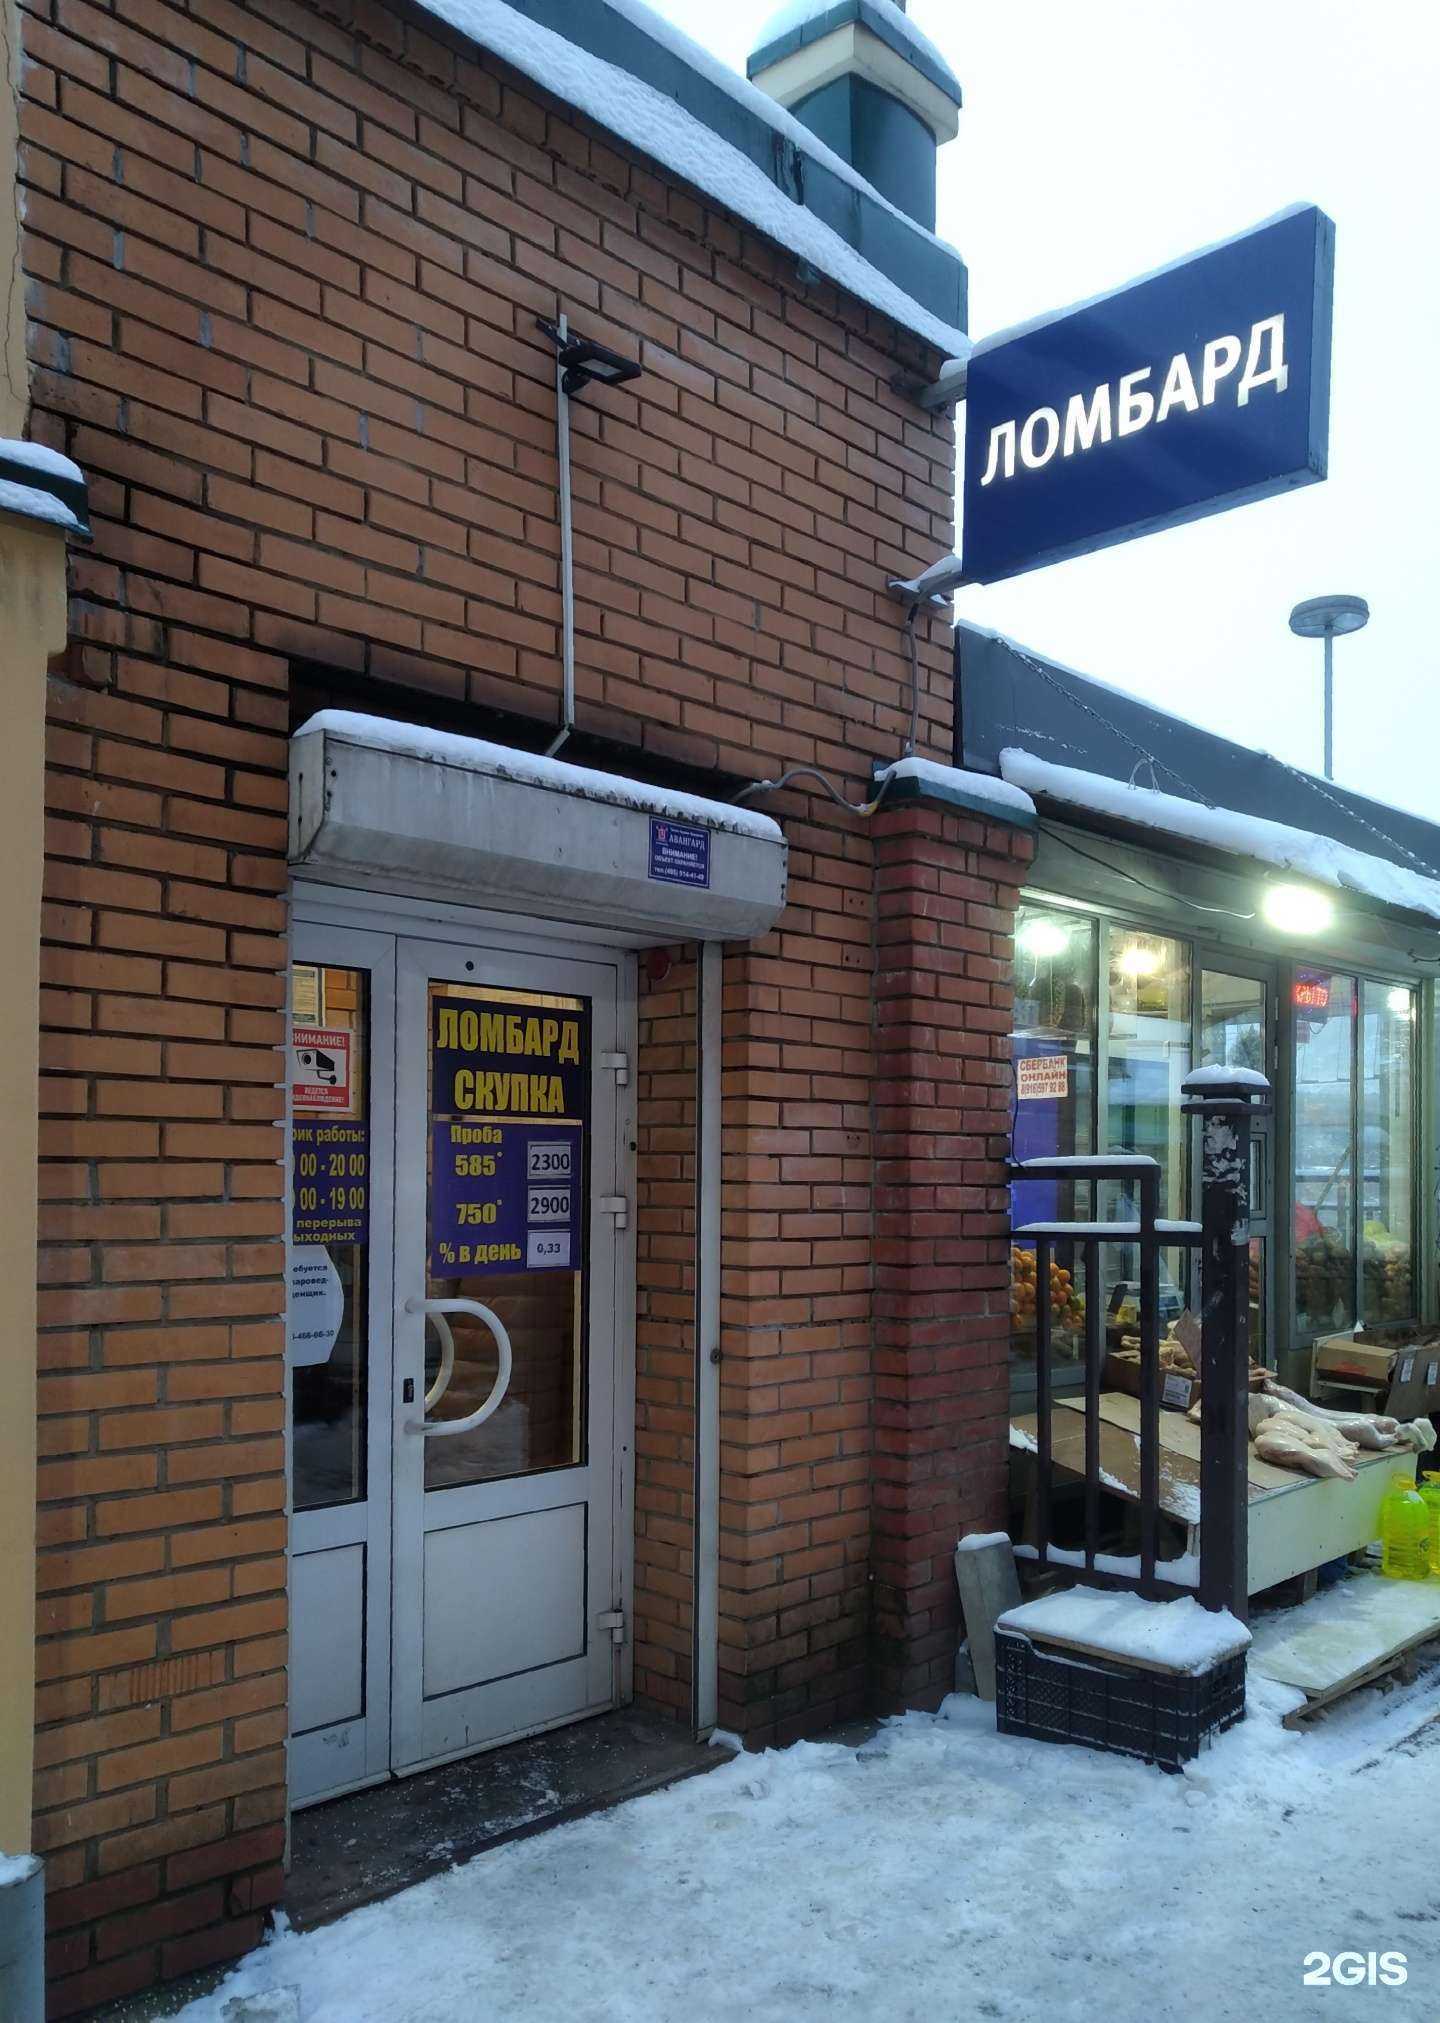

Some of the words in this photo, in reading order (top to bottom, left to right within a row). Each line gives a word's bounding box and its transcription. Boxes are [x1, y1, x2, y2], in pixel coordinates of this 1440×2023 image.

[981, 313, 1288, 486] ЛОМБАРД
[669, 834, 705, 851] АВАНГАРД
[437, 1008, 580, 1066] ЛОМБАРД
[1020, 1057, 1067, 1071] СБЕРБАНК
[1021, 1070, 1066, 1082] ОНЛАЙН
[454, 1069, 565, 1114] СКУПКА
[316, 1125, 365, 1146] работы:
[451, 1125, 502, 1144] Проба
[531, 1153, 570, 1171] 2300
[530, 1196, 570, 1215] 2900
[296, 1218, 362, 1230] перерыва
[439, 1242, 455, 1265] %
[459, 1245, 471, 1263] в
[474, 1243, 522, 1265] день
[536, 1243, 561, 1256] 0,33
